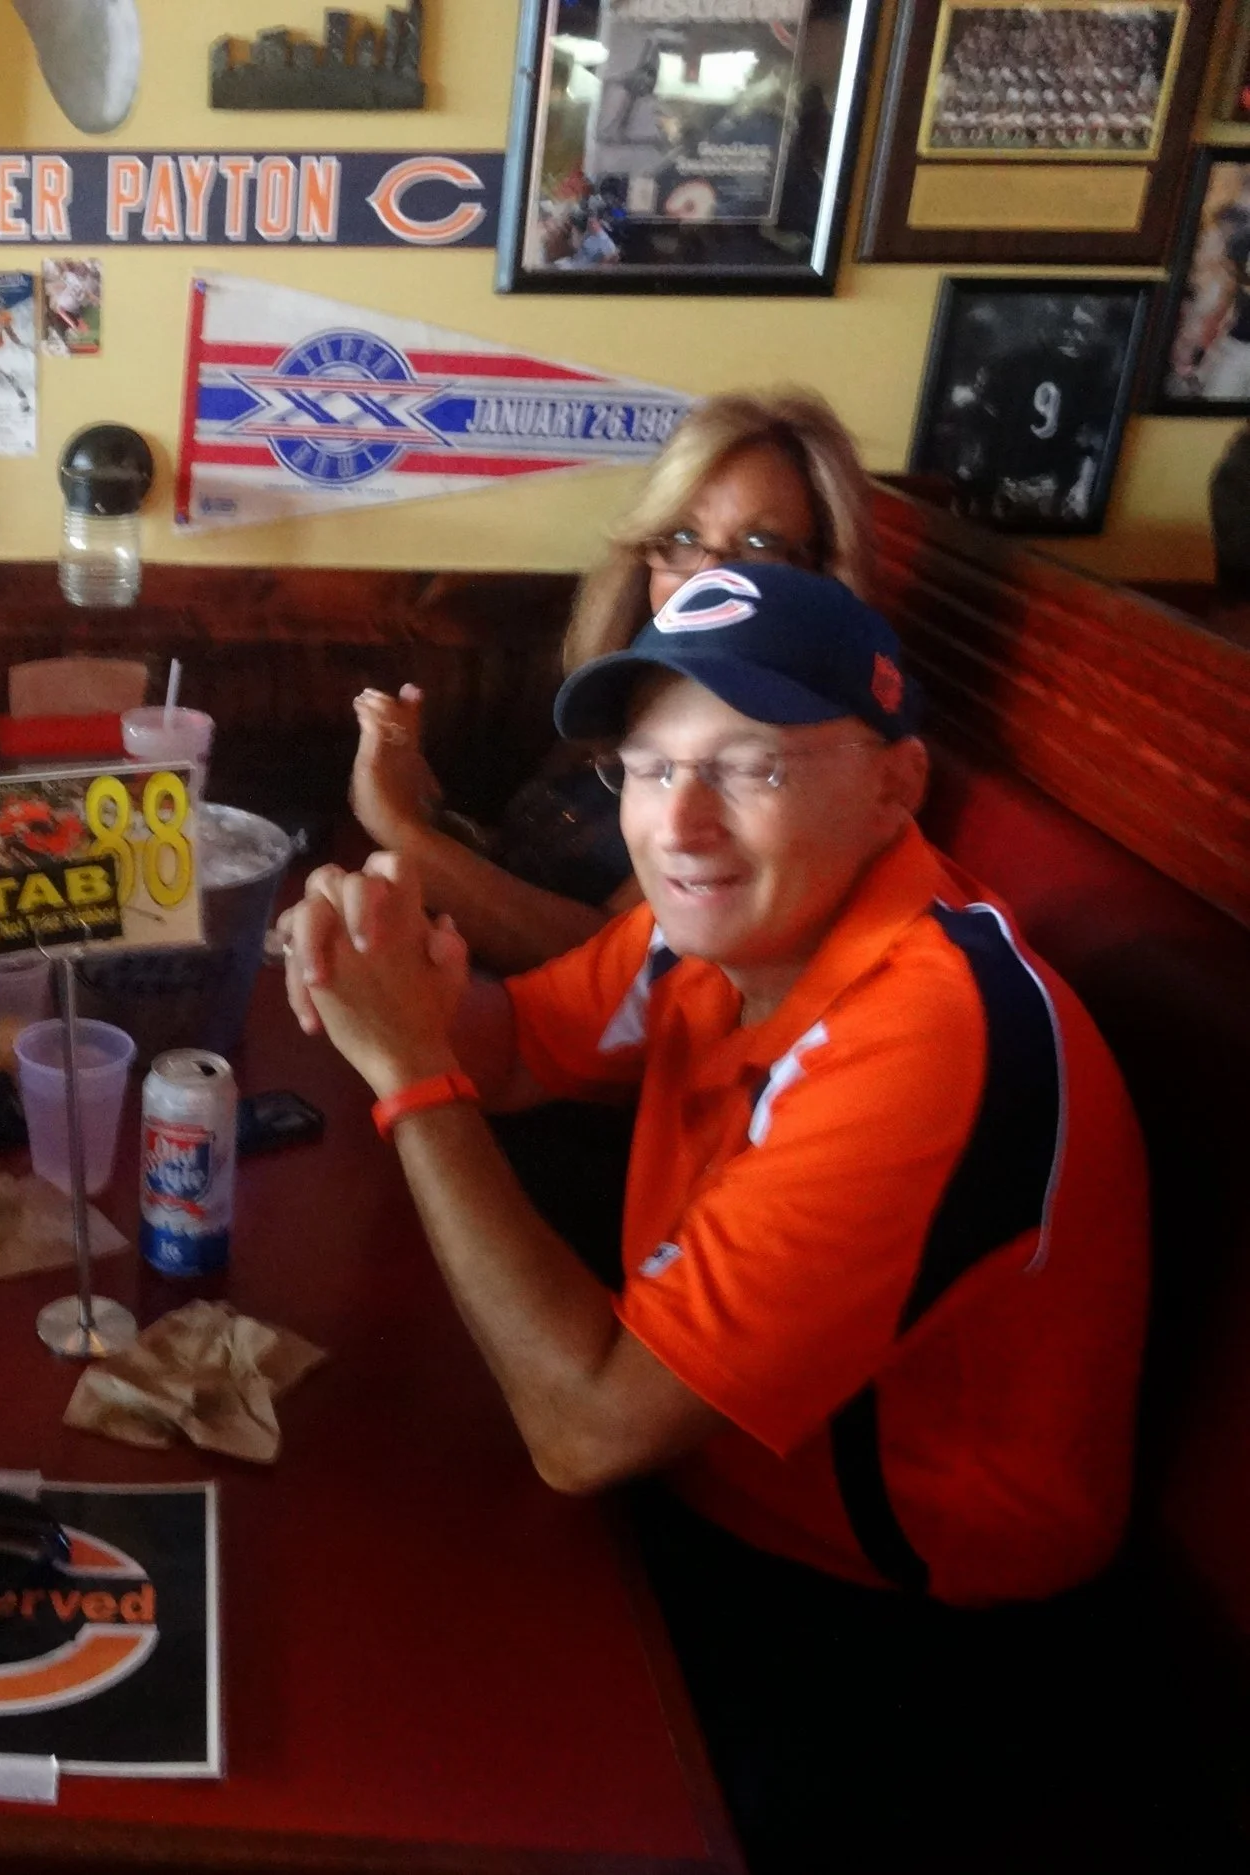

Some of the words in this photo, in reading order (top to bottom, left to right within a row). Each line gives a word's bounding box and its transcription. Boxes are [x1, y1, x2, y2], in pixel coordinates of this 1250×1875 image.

[106, 155, 342, 242] PAYTON
[365, 156, 487, 245] C
[465, 397, 587, 438] JANUARY
[1030, 381, 1062, 439] 9
[85, 771, 192, 908] 88
